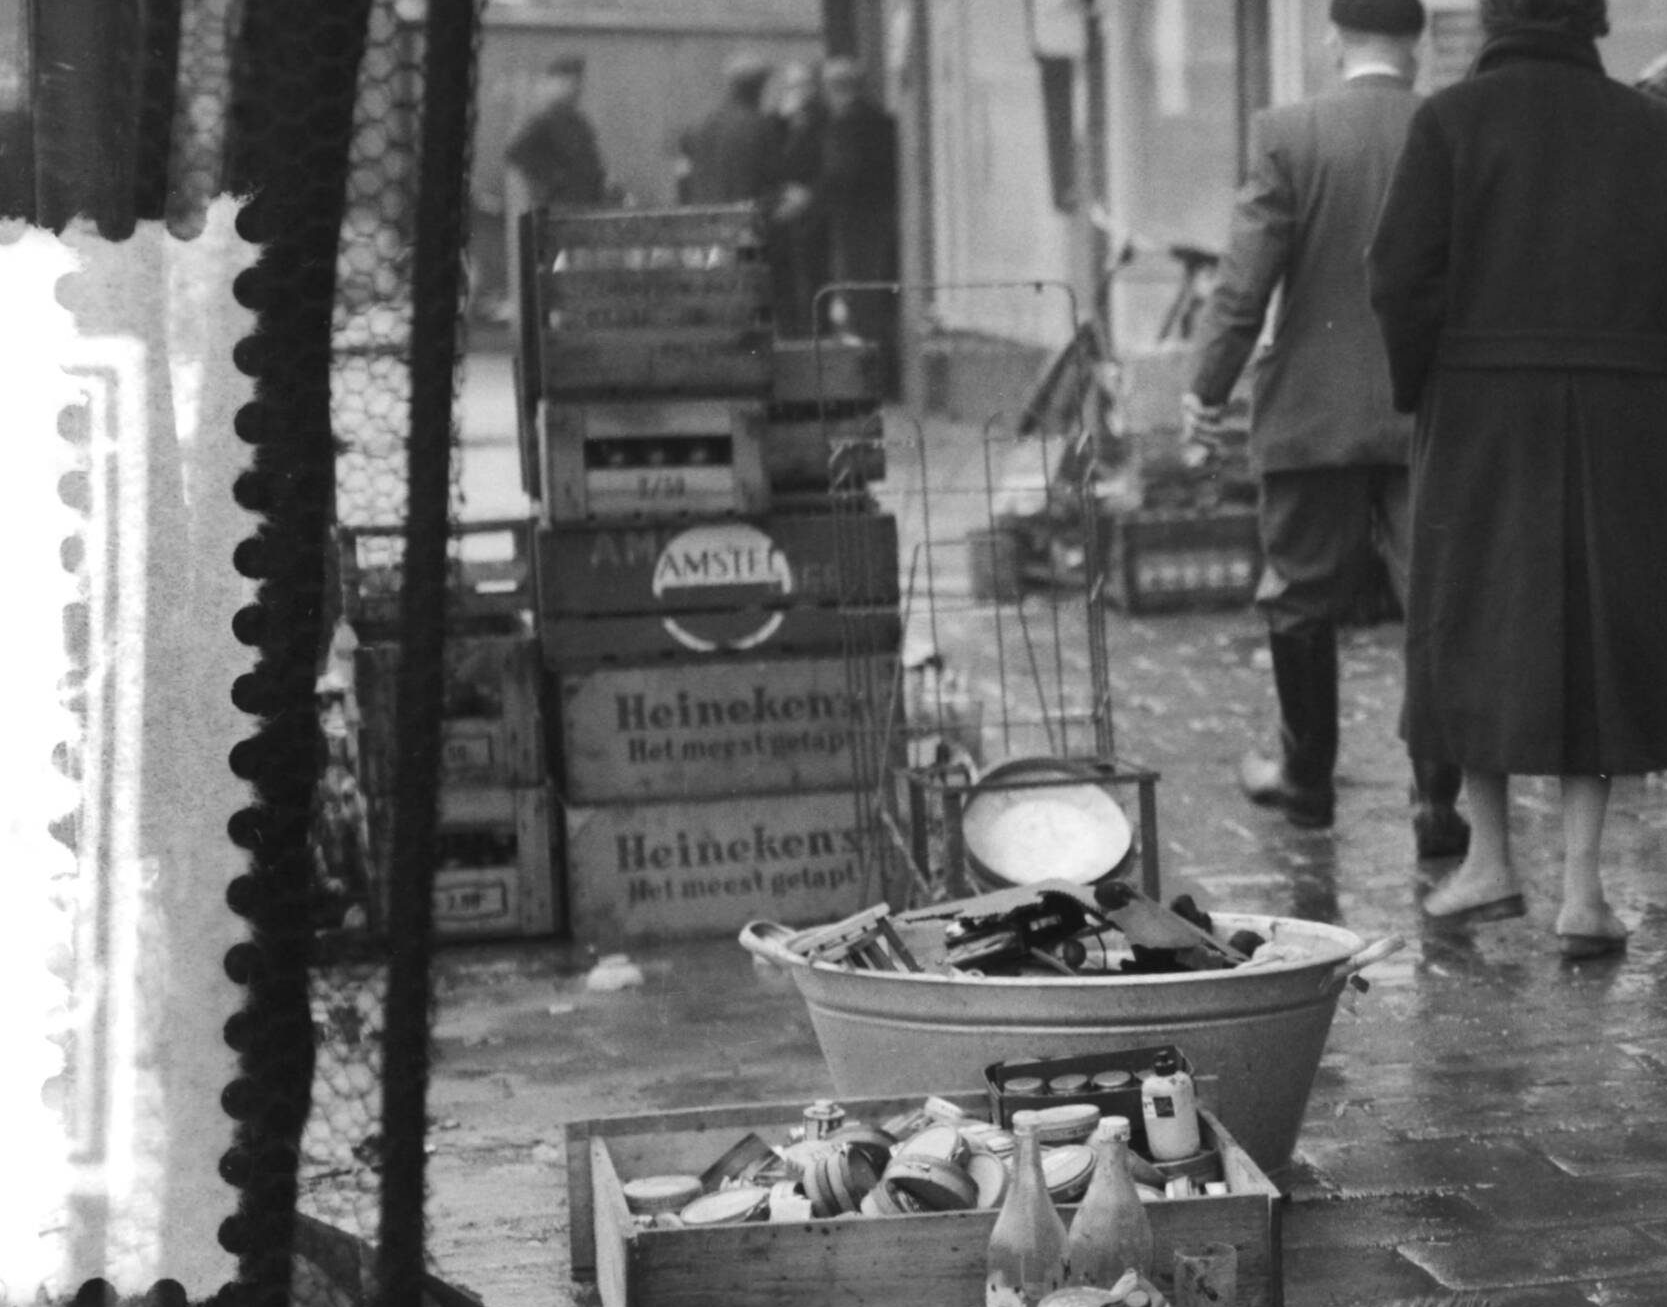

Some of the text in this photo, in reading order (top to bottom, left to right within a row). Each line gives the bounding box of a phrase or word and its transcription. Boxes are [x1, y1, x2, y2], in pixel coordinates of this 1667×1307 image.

[628, 737, 674, 764] Het
[681, 732, 764, 761] meest
[628, 859, 858, 904] Het meest getapt
